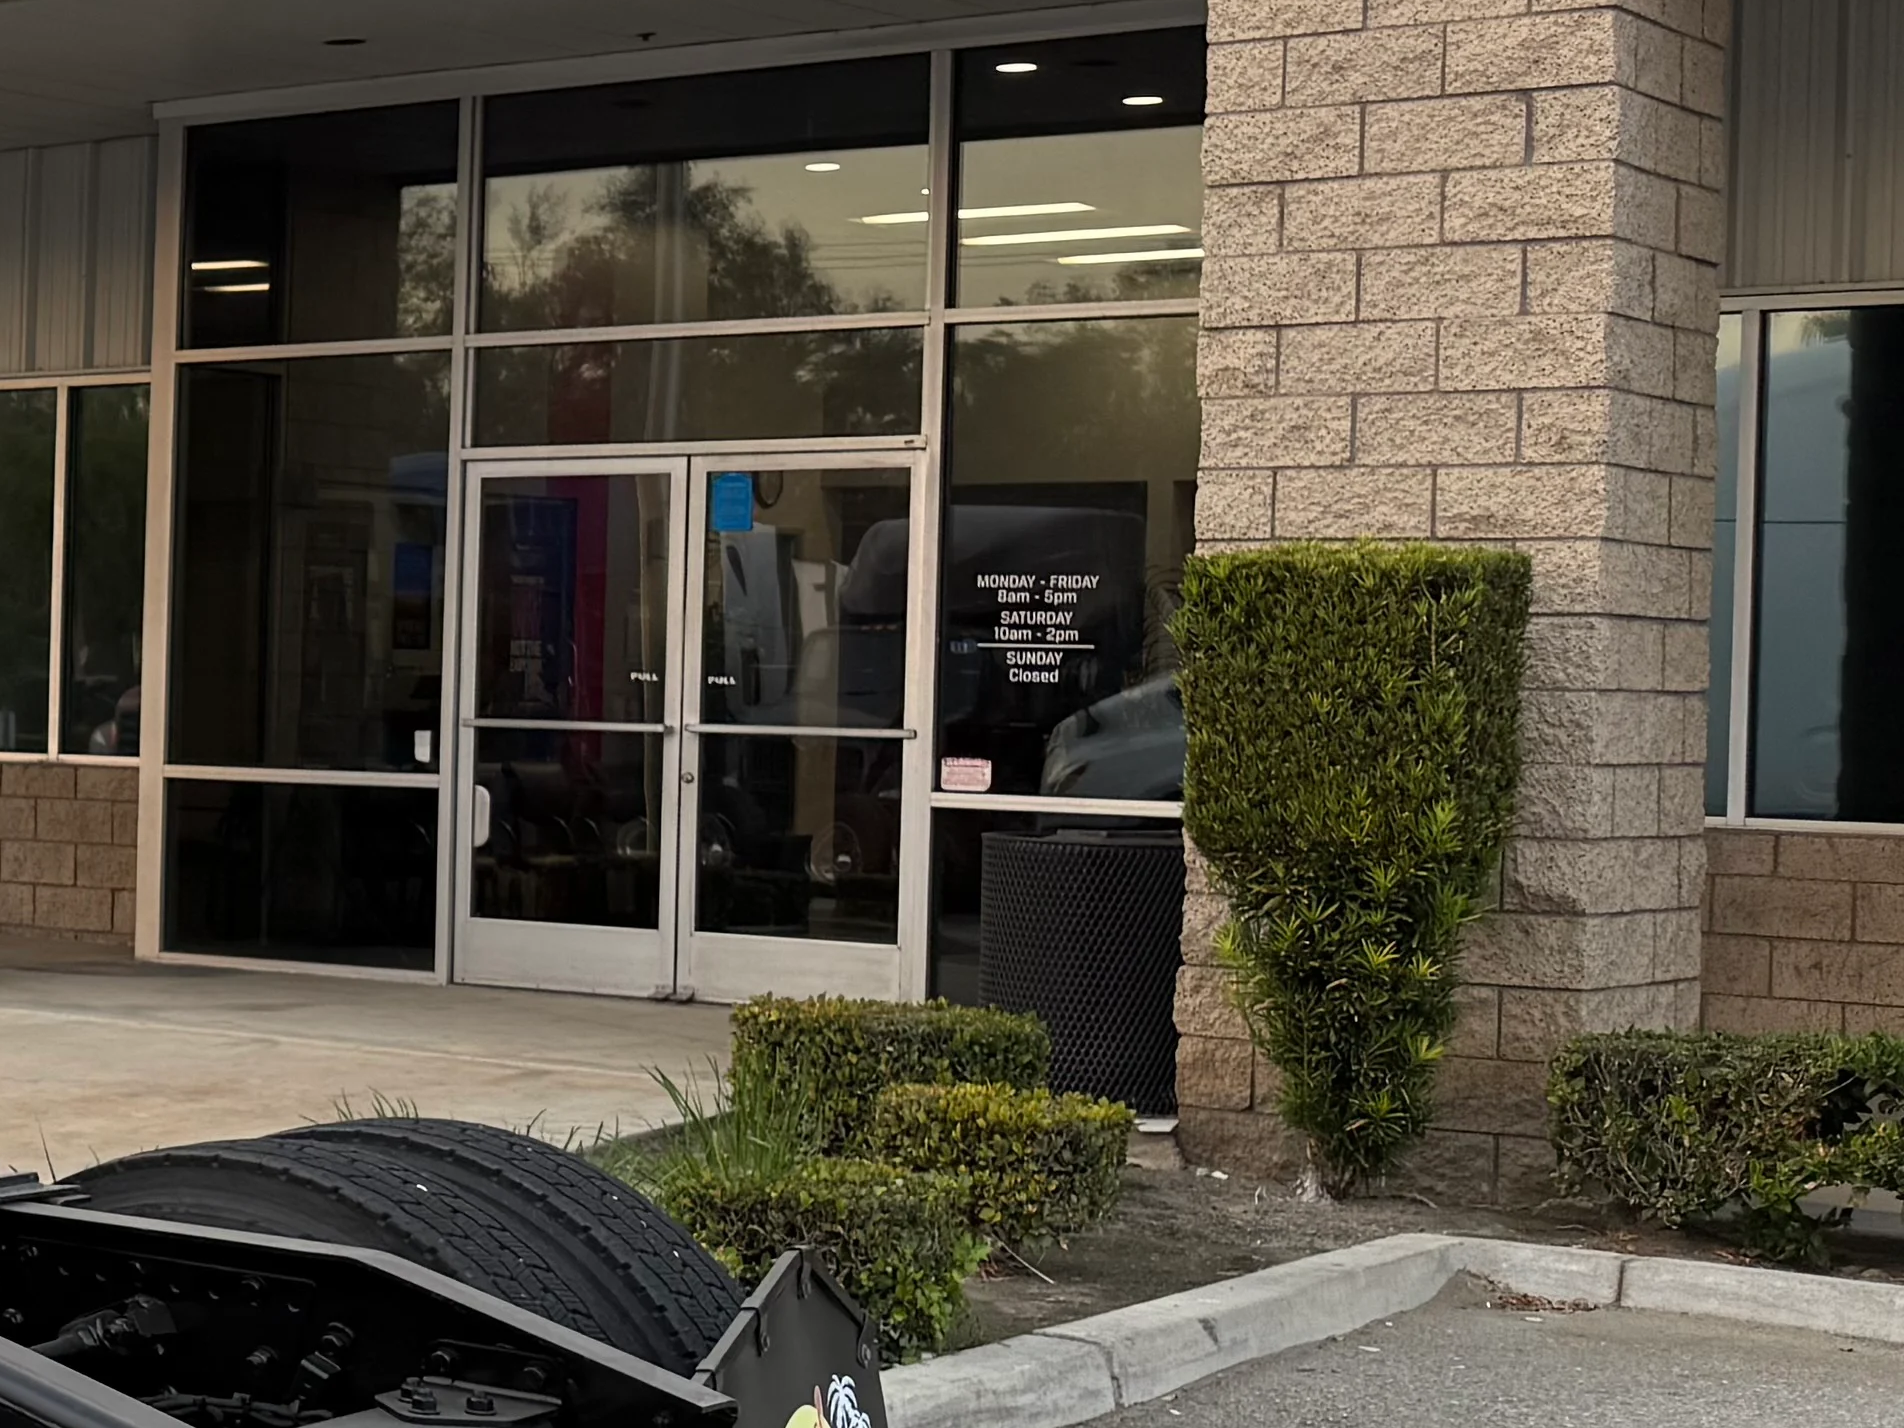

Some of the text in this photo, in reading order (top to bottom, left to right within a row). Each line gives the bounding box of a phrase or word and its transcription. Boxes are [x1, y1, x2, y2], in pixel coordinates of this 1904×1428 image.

[977, 574, 1036, 589] MONDAY
[1049, 575, 1100, 589] FRIDAY
[997, 589, 1030, 604] 8am
[1044, 589, 1078, 606] 5pm
[1000, 611, 1073, 626] SATURDAY
[994, 626, 1032, 641] 10am
[1045, 627, 1079, 644] 2pm
[1006, 651, 1064, 666] SUNDAY
[629, 671, 659, 682] PULL
[707, 675, 737, 686] PULL
[1009, 668, 1059, 684] Closed
